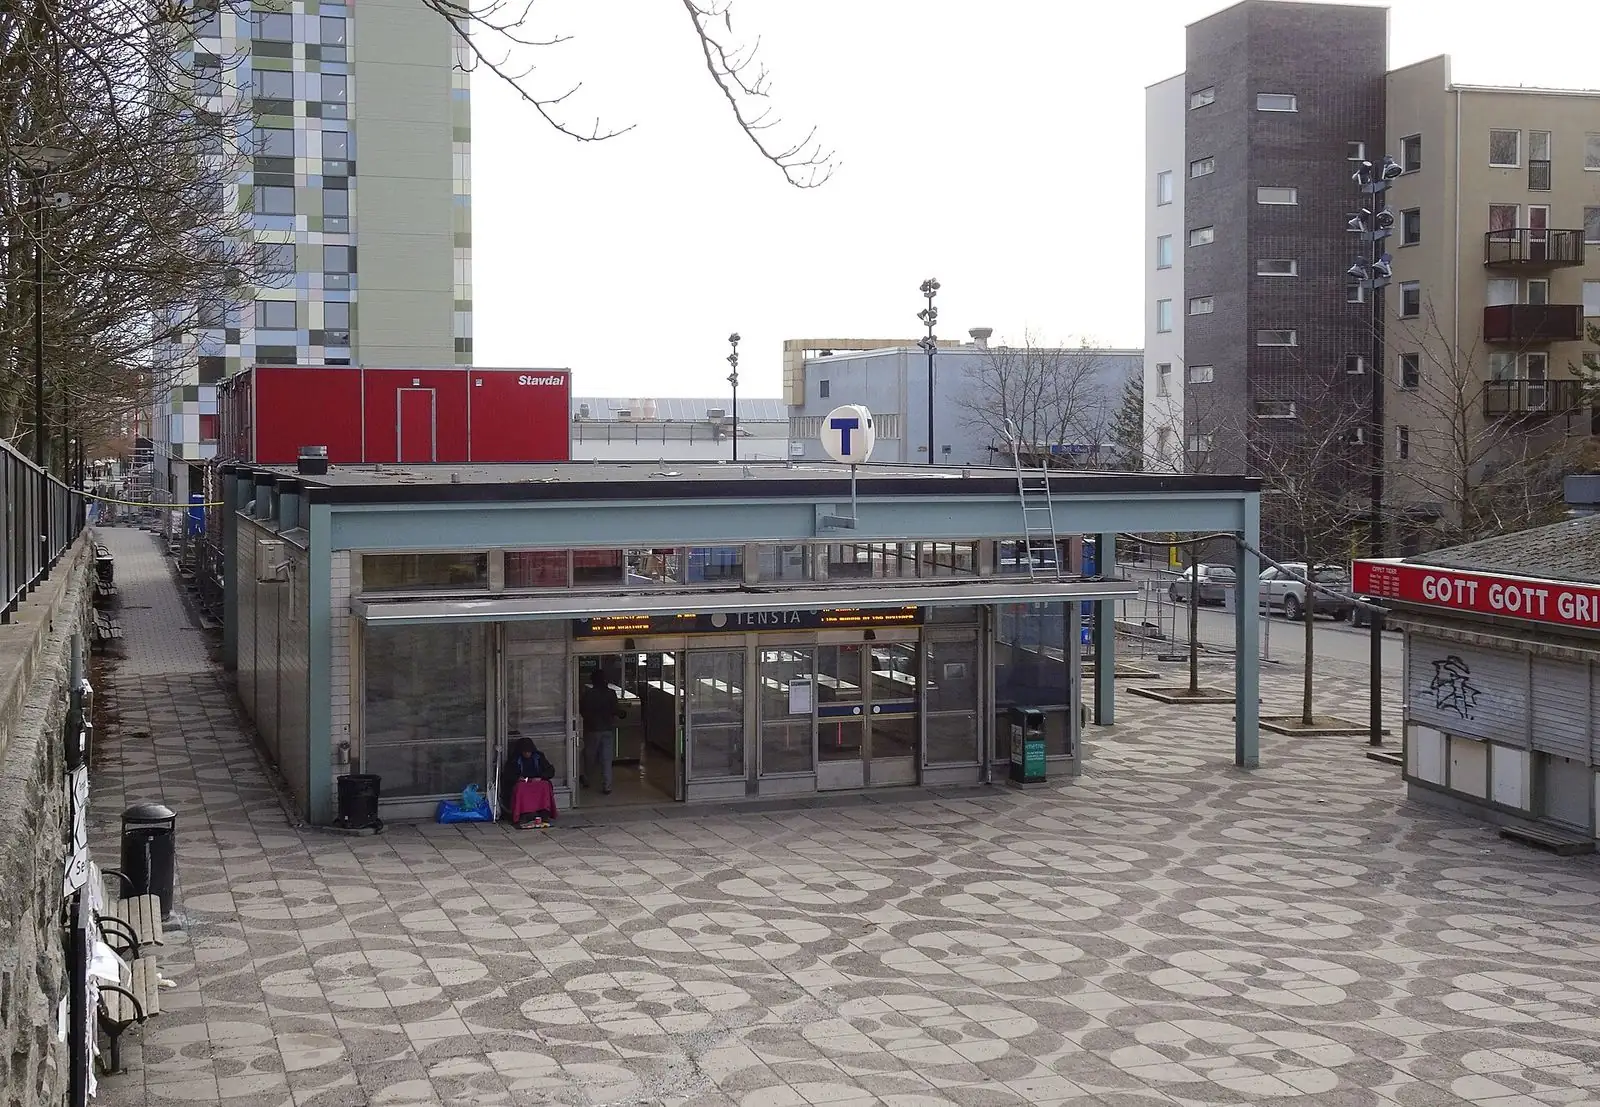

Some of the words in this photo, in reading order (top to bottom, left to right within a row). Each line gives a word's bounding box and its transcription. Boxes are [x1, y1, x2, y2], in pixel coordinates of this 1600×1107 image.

[518, 375, 564, 385] Stavdal
[831, 418, 859, 455] T
[1422, 575, 1478, 605] GOTT
[1489, 583, 1548, 615] GOTT
[1557, 592, 1598, 623] GRI
[736, 610, 801, 625] TENSTA
